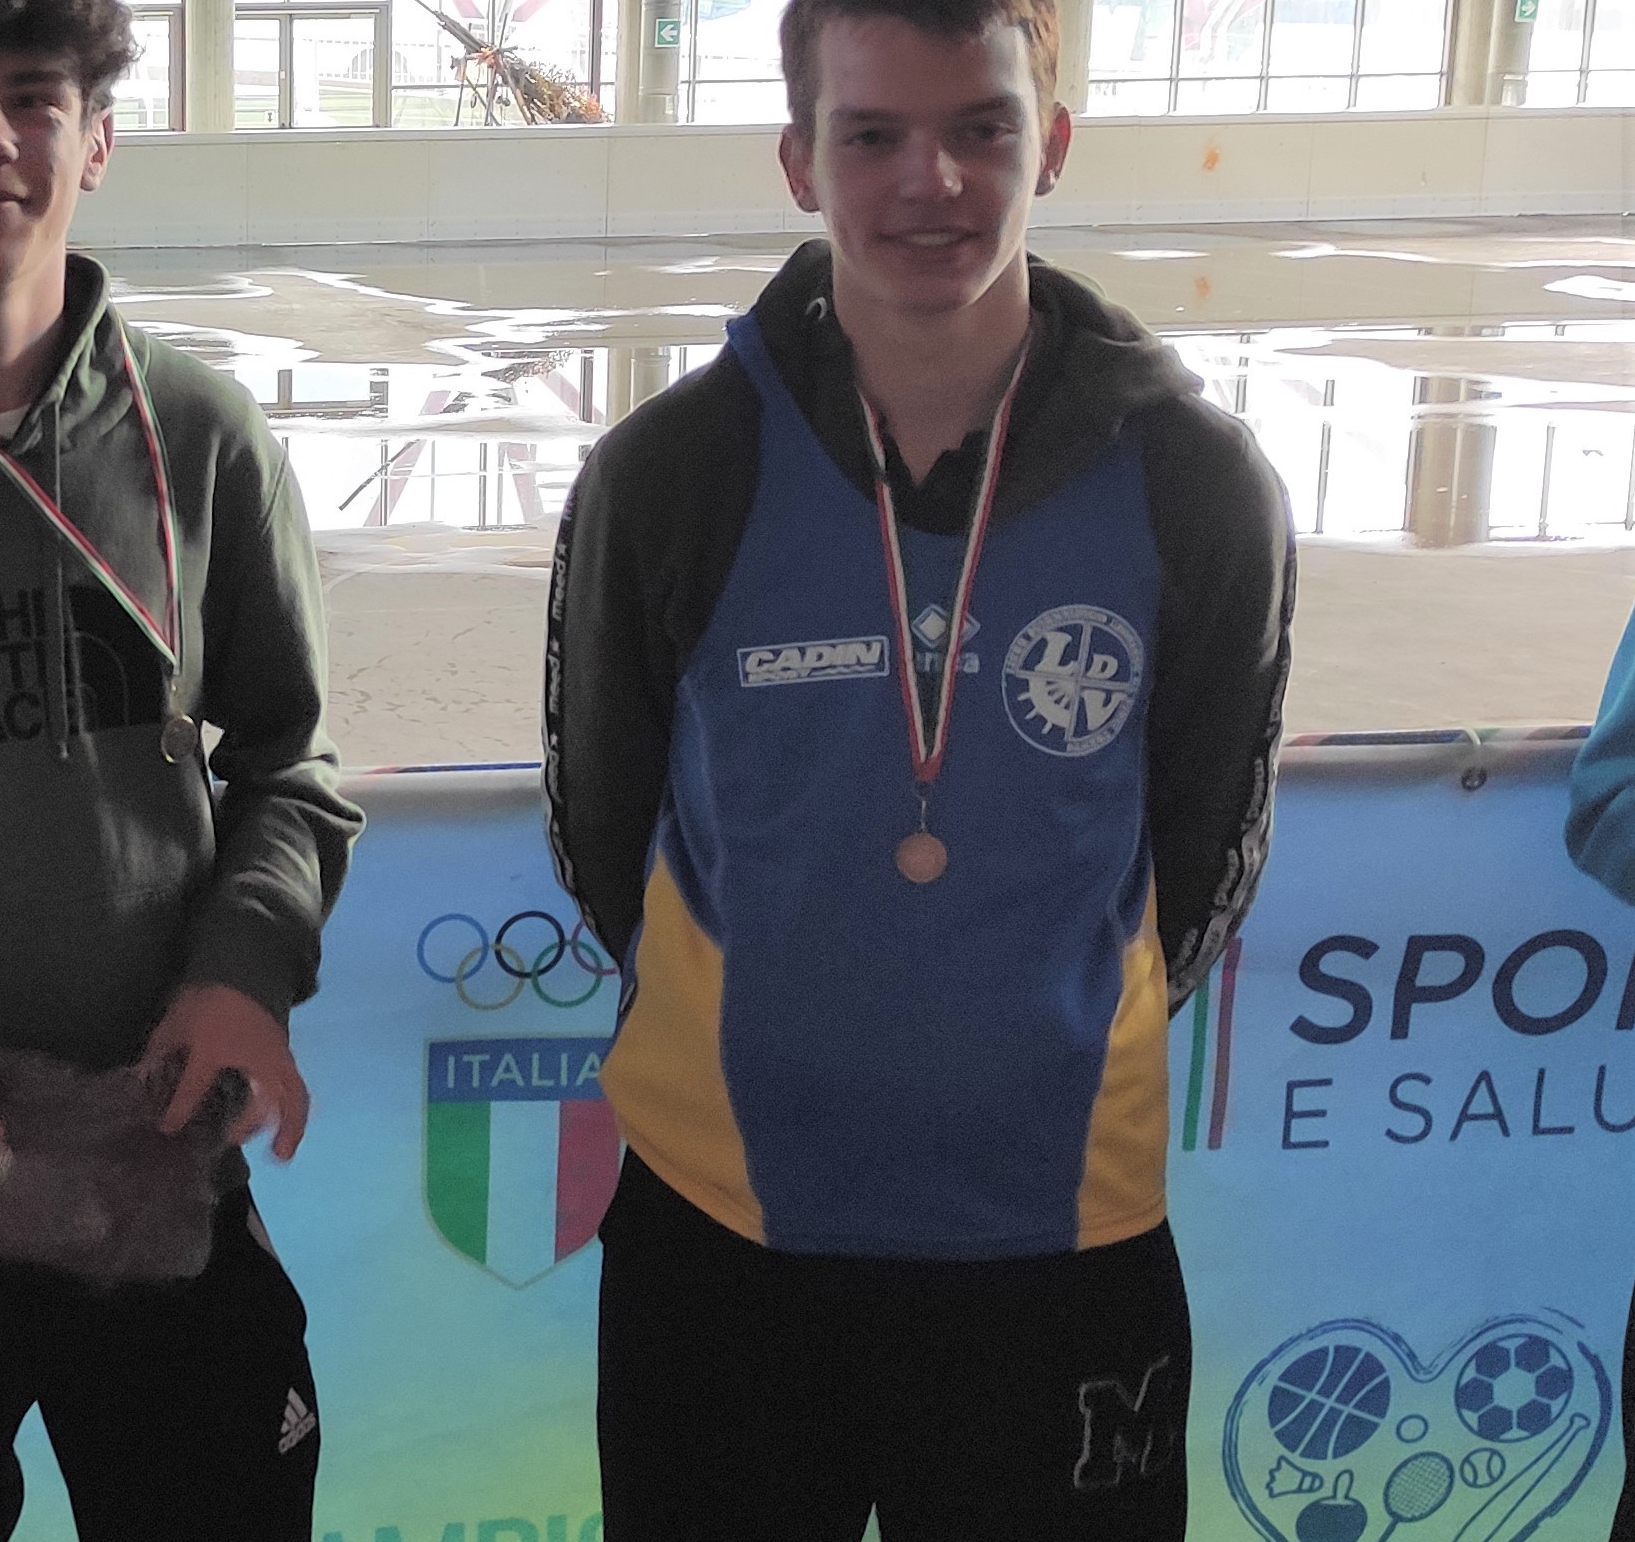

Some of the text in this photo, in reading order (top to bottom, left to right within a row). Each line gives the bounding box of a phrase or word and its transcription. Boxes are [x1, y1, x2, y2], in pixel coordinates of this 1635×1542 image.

[447, 1052, 604, 1089] ITALIA
[1282, 1064, 1635, 1150] E SALU
